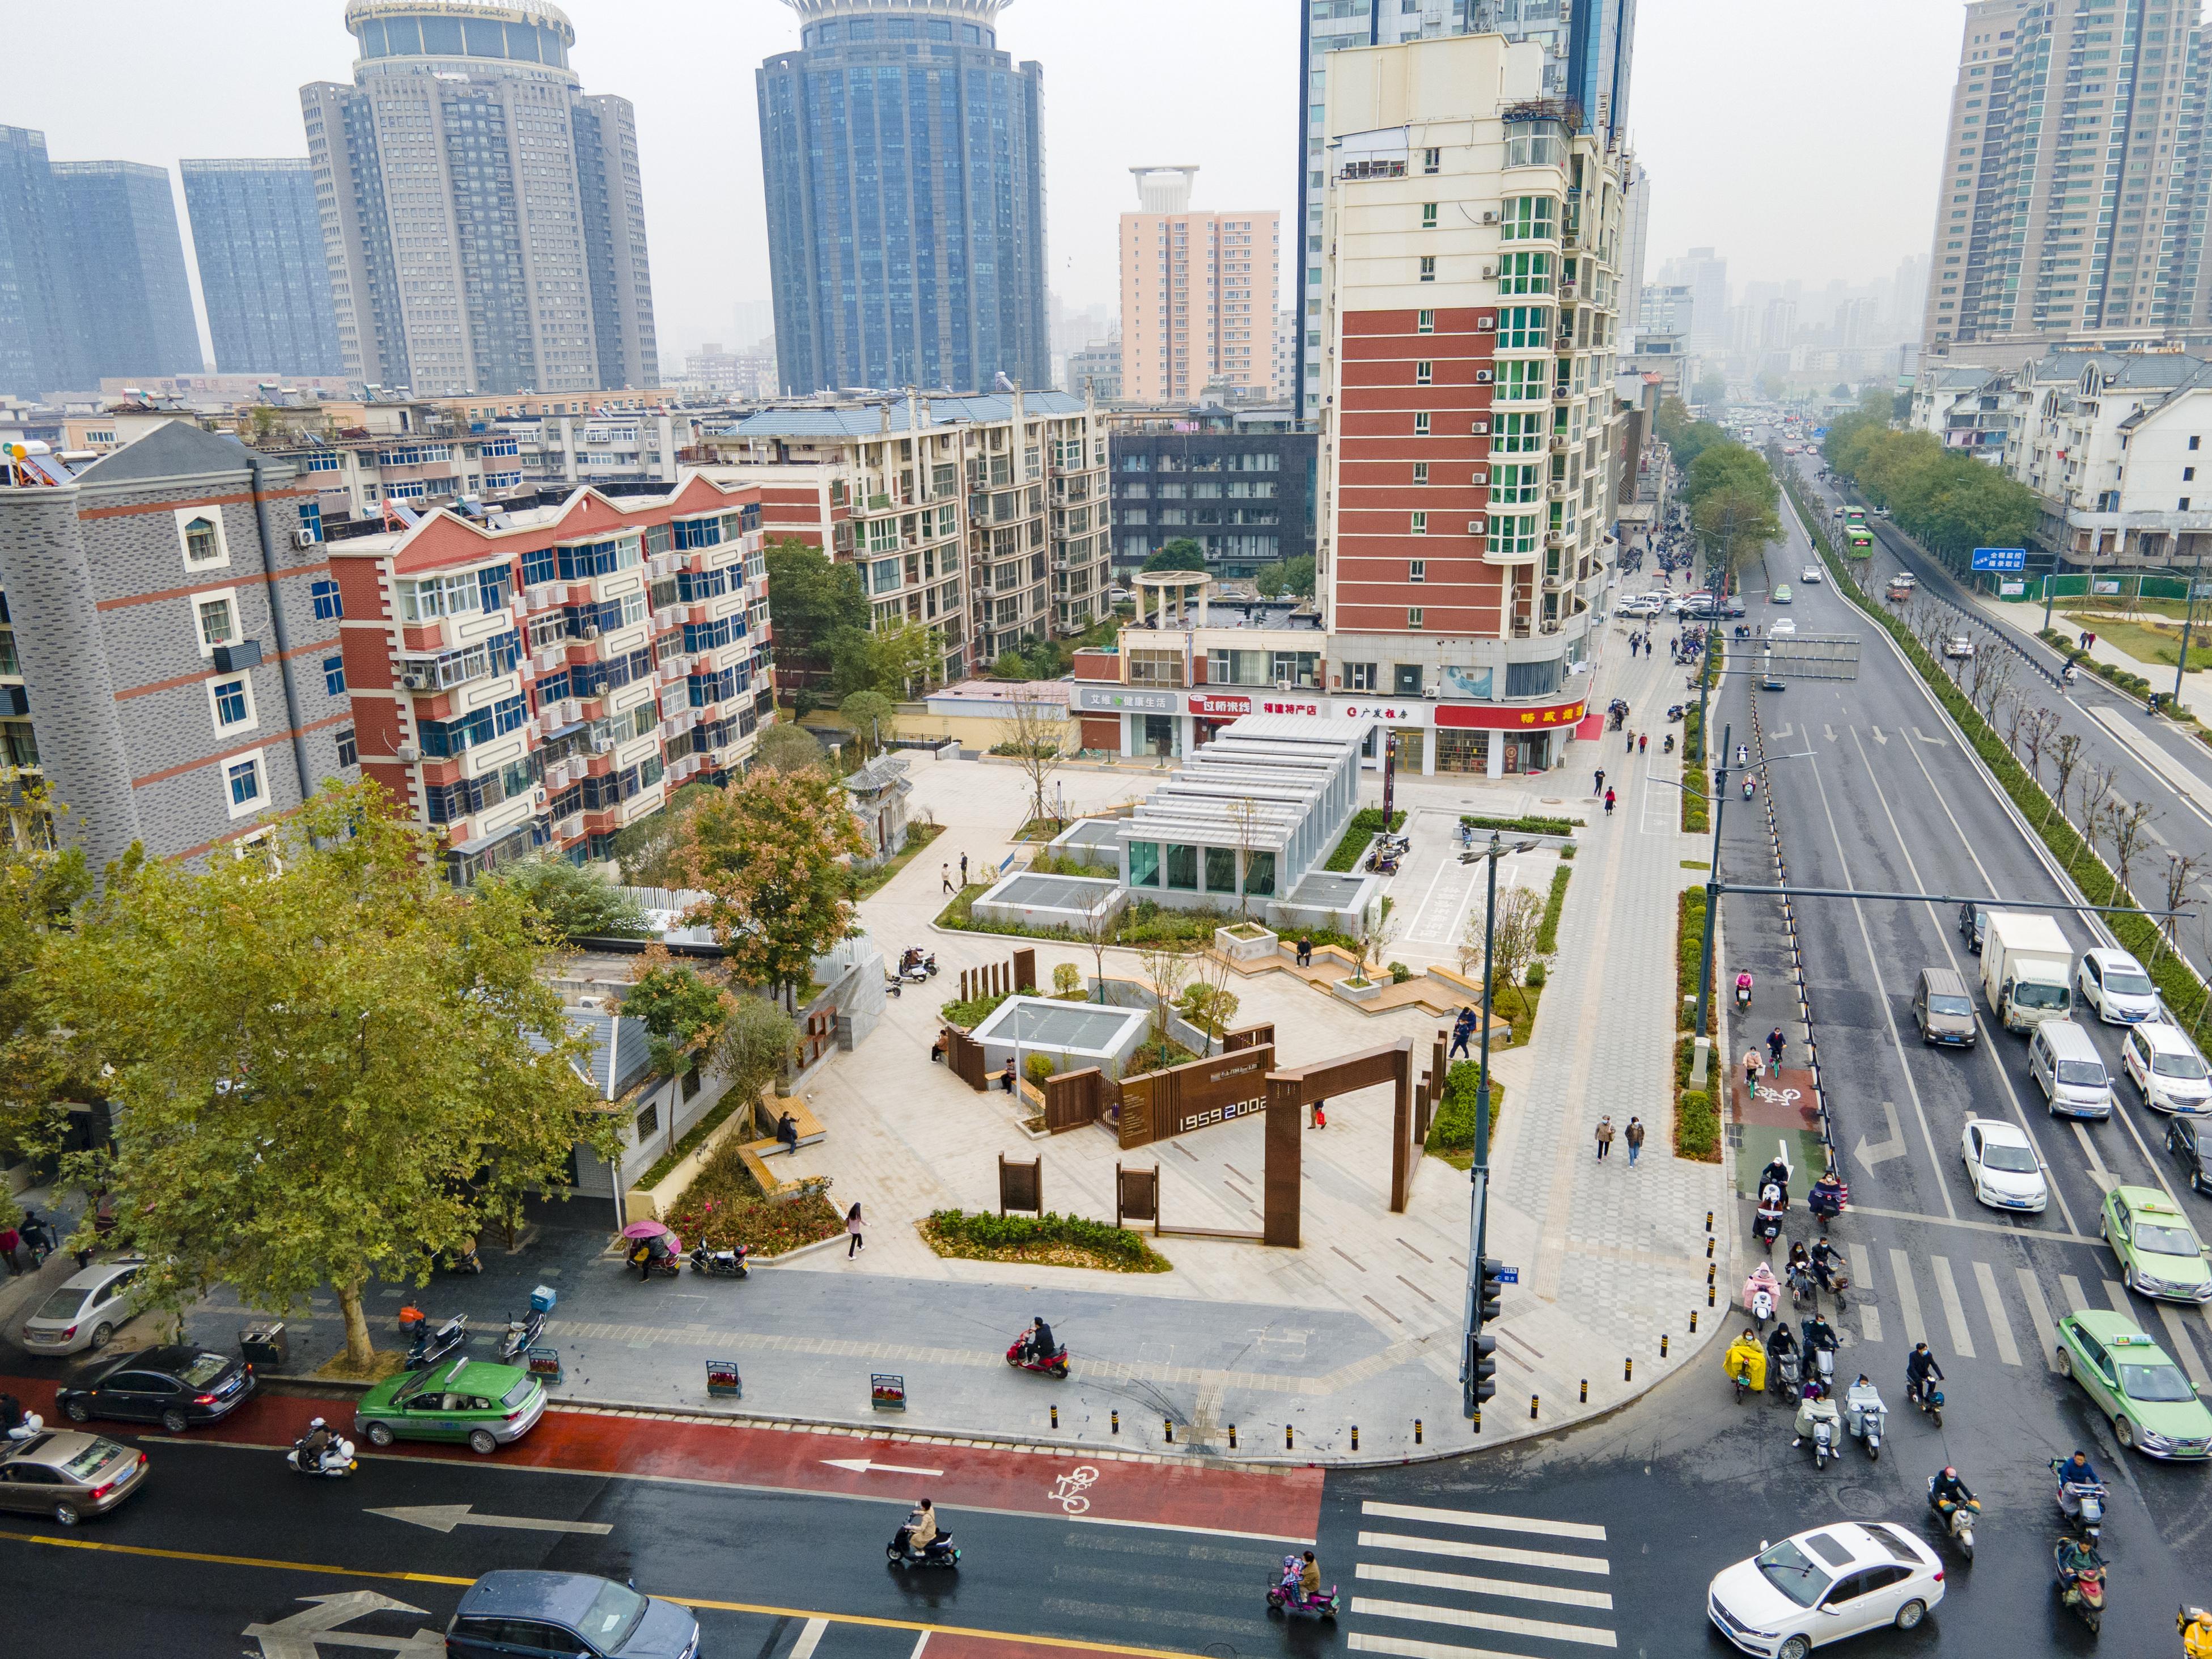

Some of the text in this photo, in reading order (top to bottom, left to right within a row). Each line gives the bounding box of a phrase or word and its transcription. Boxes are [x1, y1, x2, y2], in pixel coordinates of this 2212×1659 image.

[1123, 696, 1166, 708] 健康生活
[1203, 700, 1251, 713] 过桥米线
[1264, 702, 1317, 716] 福建特产店
[1361, 708, 1408, 719] 广发租房
